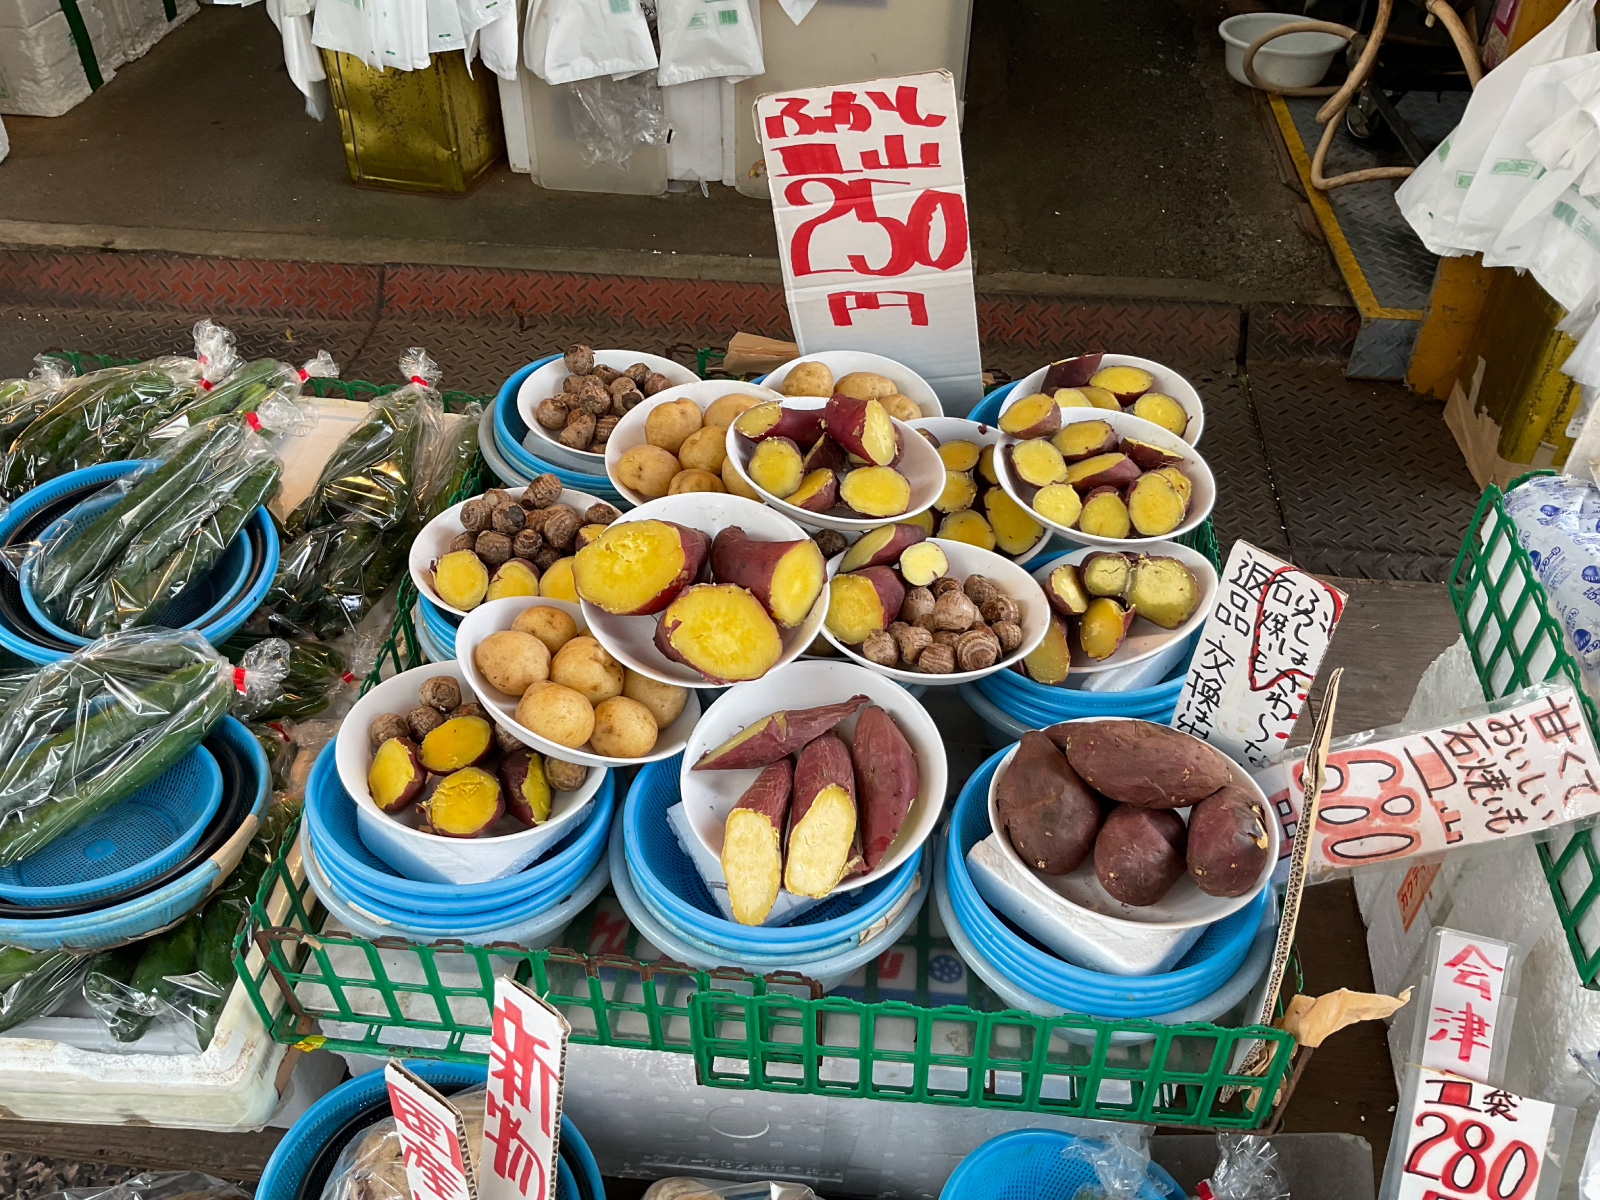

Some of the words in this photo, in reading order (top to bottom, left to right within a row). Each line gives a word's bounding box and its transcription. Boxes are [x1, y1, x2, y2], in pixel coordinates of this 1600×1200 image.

[765, 86, 947, 139] ふかし
[784, 177, 968, 277] 250
[827, 290, 929, 327] 円
[1441, 721, 1529, 835] 石焼いも
[1488, 714, 1554, 822] おいしい
[1532, 696, 1599, 803] 甘くて
[1292, 749, 1422, 865] 680
[1428, 943, 1504, 1076] 会津
[386, 1081, 466, 1200] 国産
[484, 996, 559, 1200] 新物
[1403, 1110, 1540, 1200] 280
